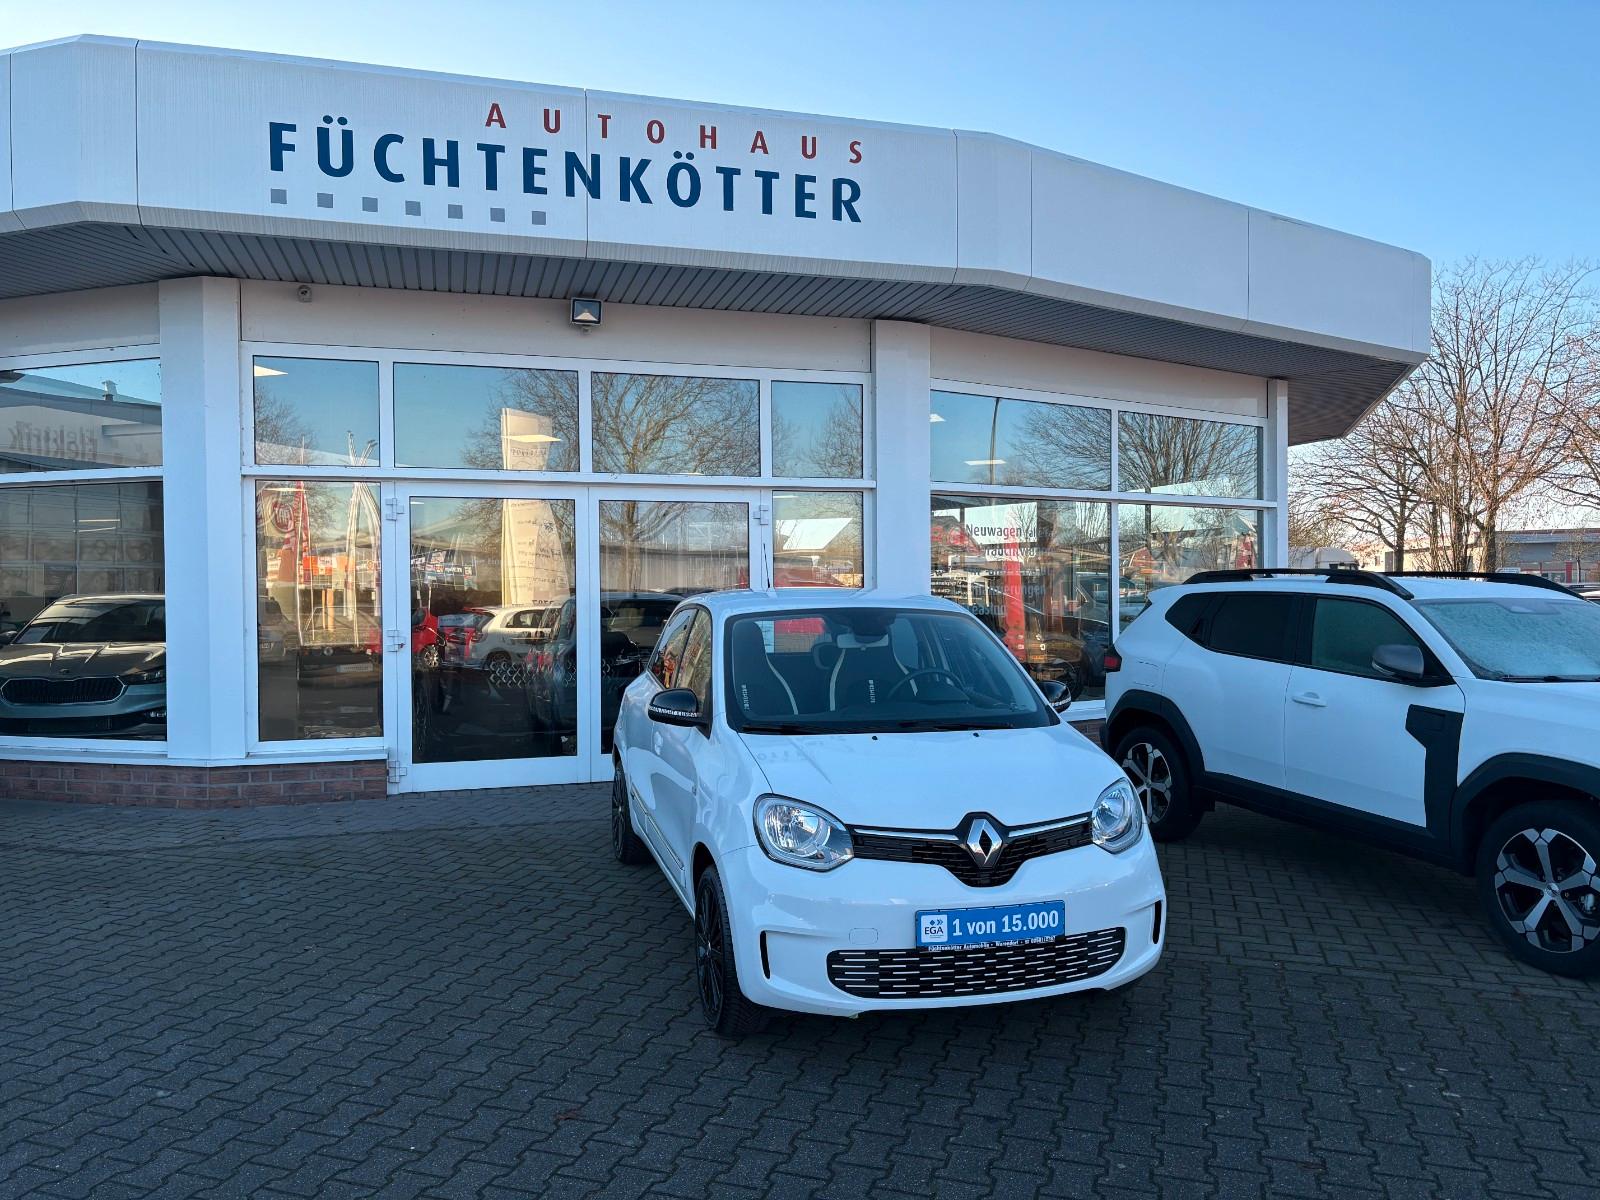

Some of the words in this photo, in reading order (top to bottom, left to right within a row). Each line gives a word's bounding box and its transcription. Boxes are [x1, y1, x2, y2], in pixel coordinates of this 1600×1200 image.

[485, 103, 862, 164] AUTOHAUS
[269, 115, 862, 223] FÜCHTENKÖTTER
[966, 523, 1022, 540] Neuwagen
[924, 925, 944, 935] EGA
[952, 918, 963, 937] 1
[966, 919, 996, 936] von
[1002, 910, 1059, 933] 15.000
